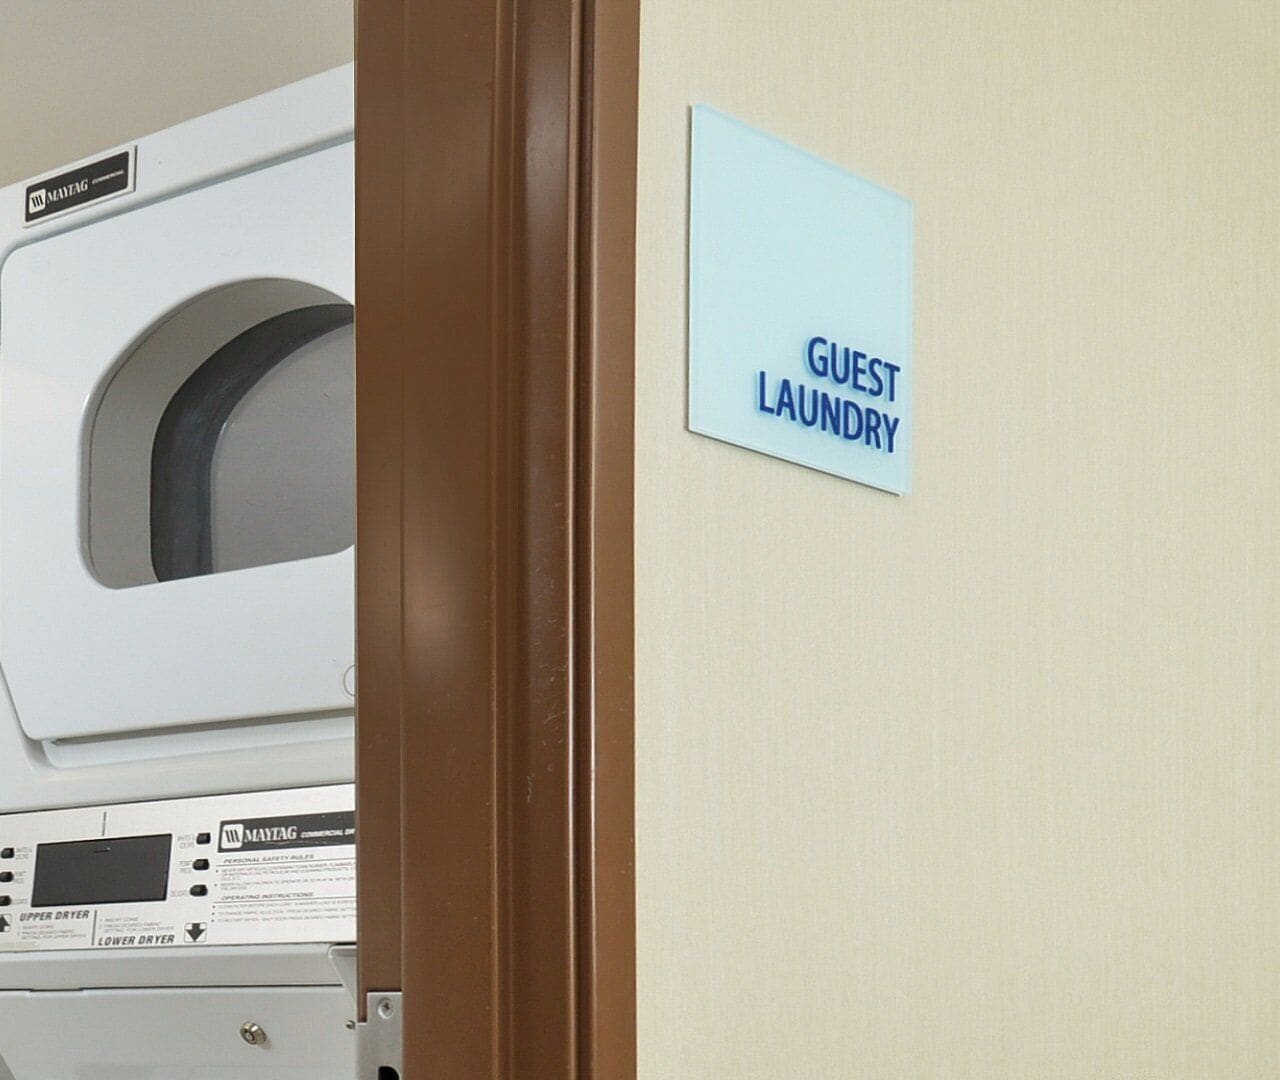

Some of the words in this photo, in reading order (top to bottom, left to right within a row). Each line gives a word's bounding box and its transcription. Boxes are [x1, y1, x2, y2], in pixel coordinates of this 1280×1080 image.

[46, 179, 89, 204] MAYTAG
[807, 336, 901, 402] GUEST
[759, 370, 900, 454] LAUNDRY
[244, 826, 297, 842] MAYTAG
[19, 911, 53, 922] UPPER
[54, 909, 90, 920] DRYER
[97, 935, 136, 946] LOWER
[138, 934, 175, 945] DRYER
